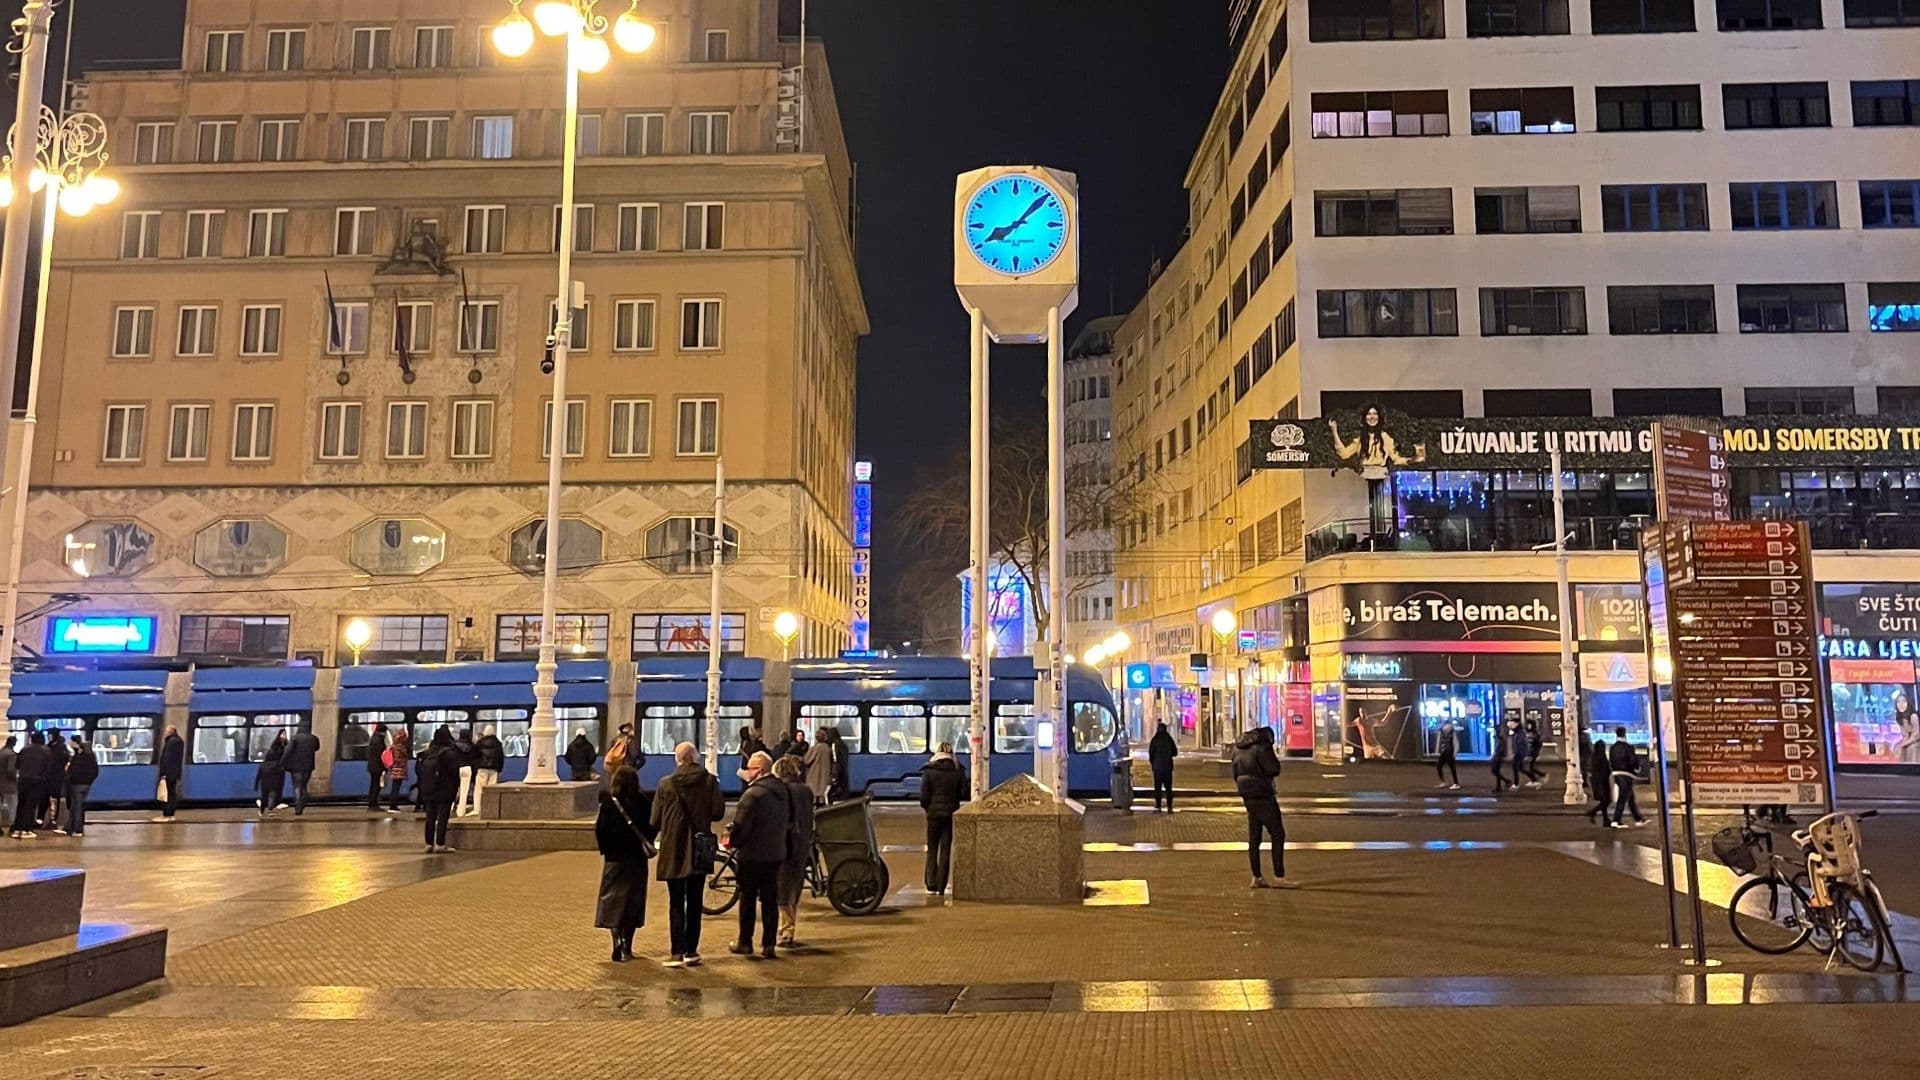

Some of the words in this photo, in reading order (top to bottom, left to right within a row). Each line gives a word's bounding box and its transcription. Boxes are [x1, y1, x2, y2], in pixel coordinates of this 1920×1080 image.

[1440, 426, 1539, 454] UŽIVANJE
[1544, 430, 1559, 452] U
[1565, 430, 1633, 453] RITMU
[1723, 429, 1771, 452] MOJ
[1776, 428, 1891, 452] SOMERSBY
[1266, 452, 1310, 462] SOMERSBY
[853, 552, 869, 650] DUBROVNI
[1360, 599, 1422, 622] biraš
[1426, 599, 1558, 623] Telemach.
[1859, 596, 1891, 612] SVE
[1879, 613, 1917, 632] ČUTI
